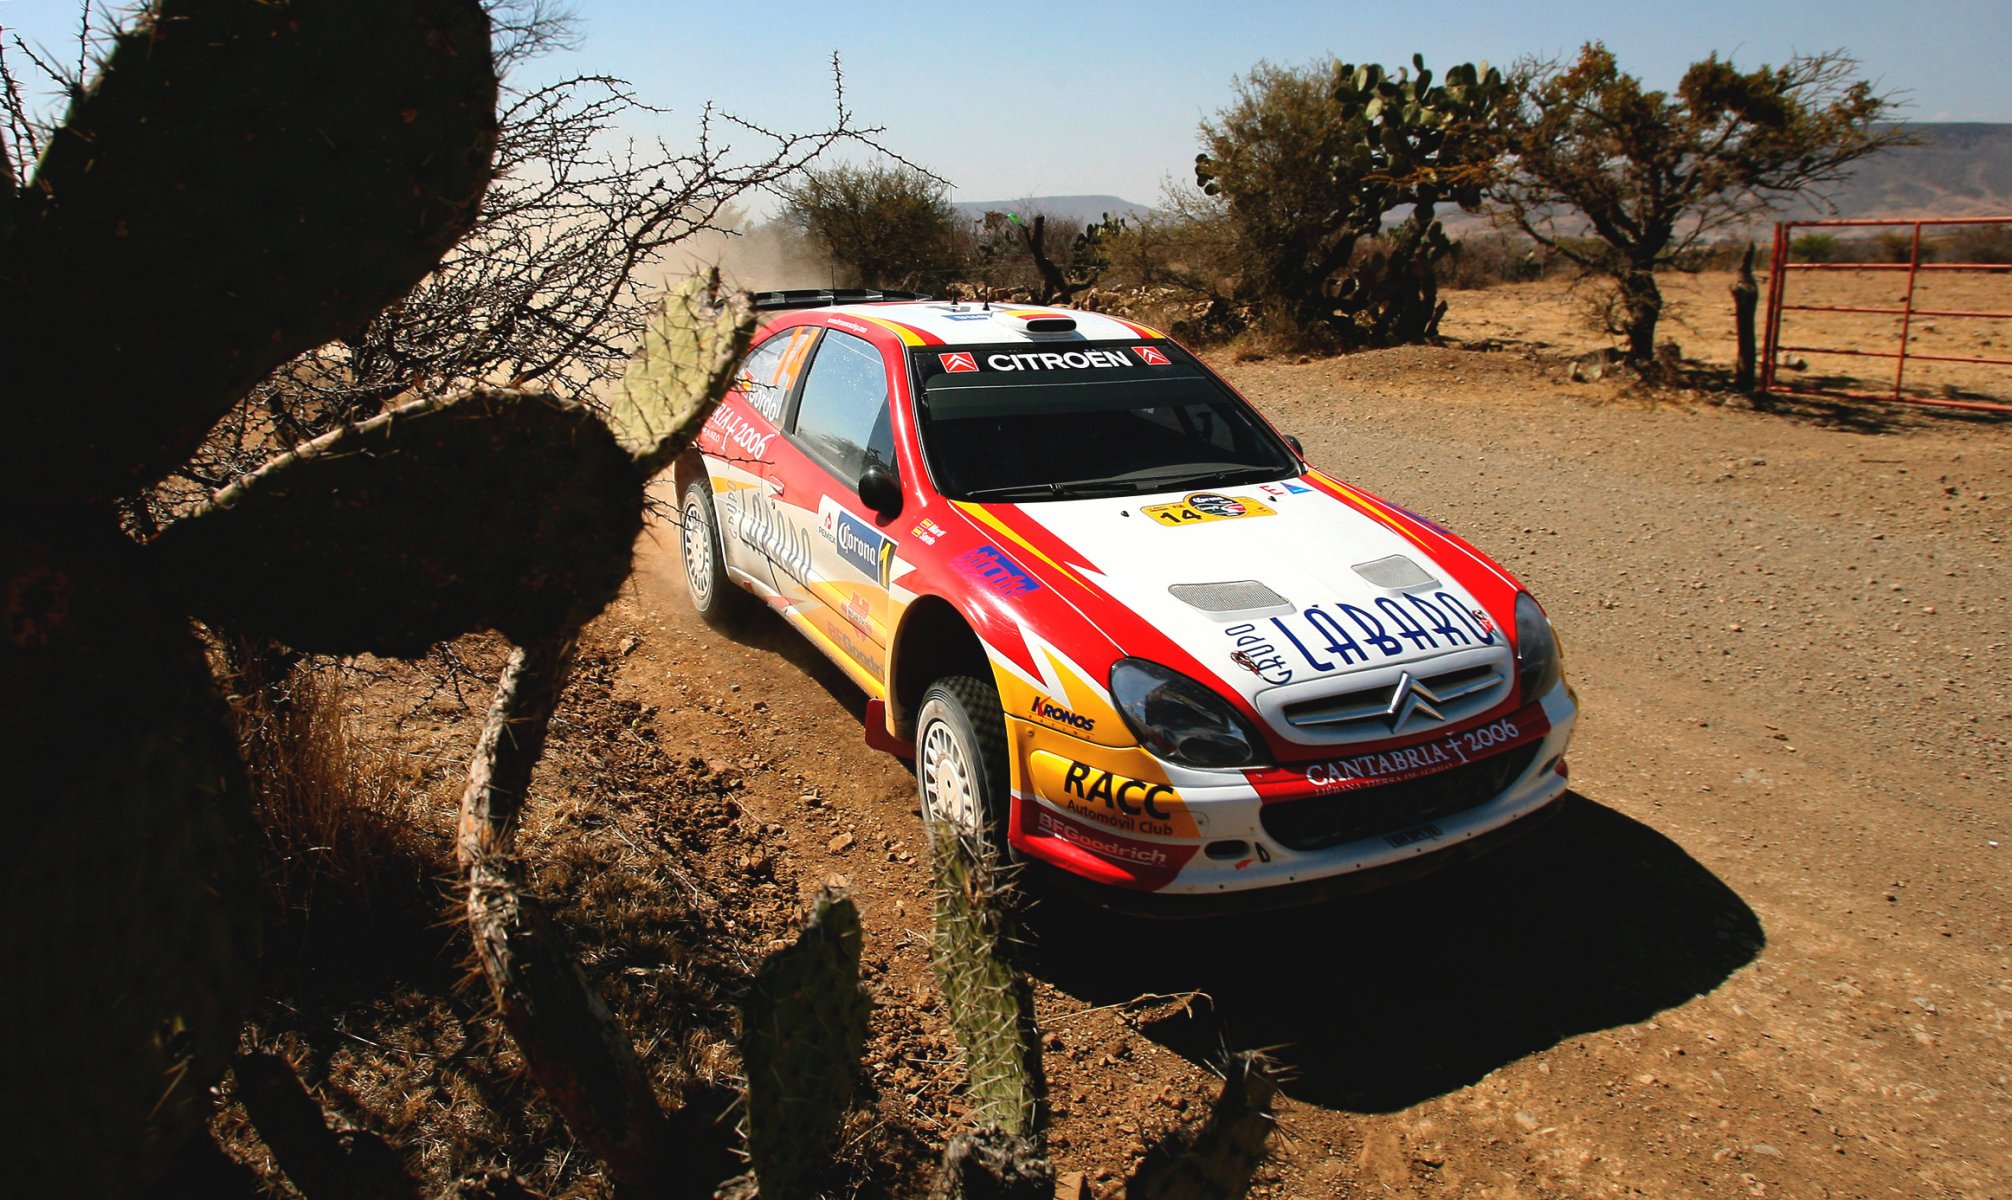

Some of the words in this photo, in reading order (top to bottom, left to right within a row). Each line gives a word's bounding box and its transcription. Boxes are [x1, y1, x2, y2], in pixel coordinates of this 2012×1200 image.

[987, 348, 1133, 372] CITROËN
[733, 422, 775, 460] 2006
[1160, 509, 1202, 523] 14
[838, 521, 877, 567] Corona
[1224, 623, 1294, 686] GRUPO
[1269, 591, 1495, 673] LÁBARO
[1030, 695, 1097, 732] KRONOS
[1305, 743, 1451, 787] CANTABRIA
[1464, 718, 1520, 752] 2006
[1063, 759, 1175, 821] RACC
[1038, 812, 1168, 864] BFGoodrich
[1066, 798, 1135, 832] Automóvil
[1138, 820, 1174, 836] Club
